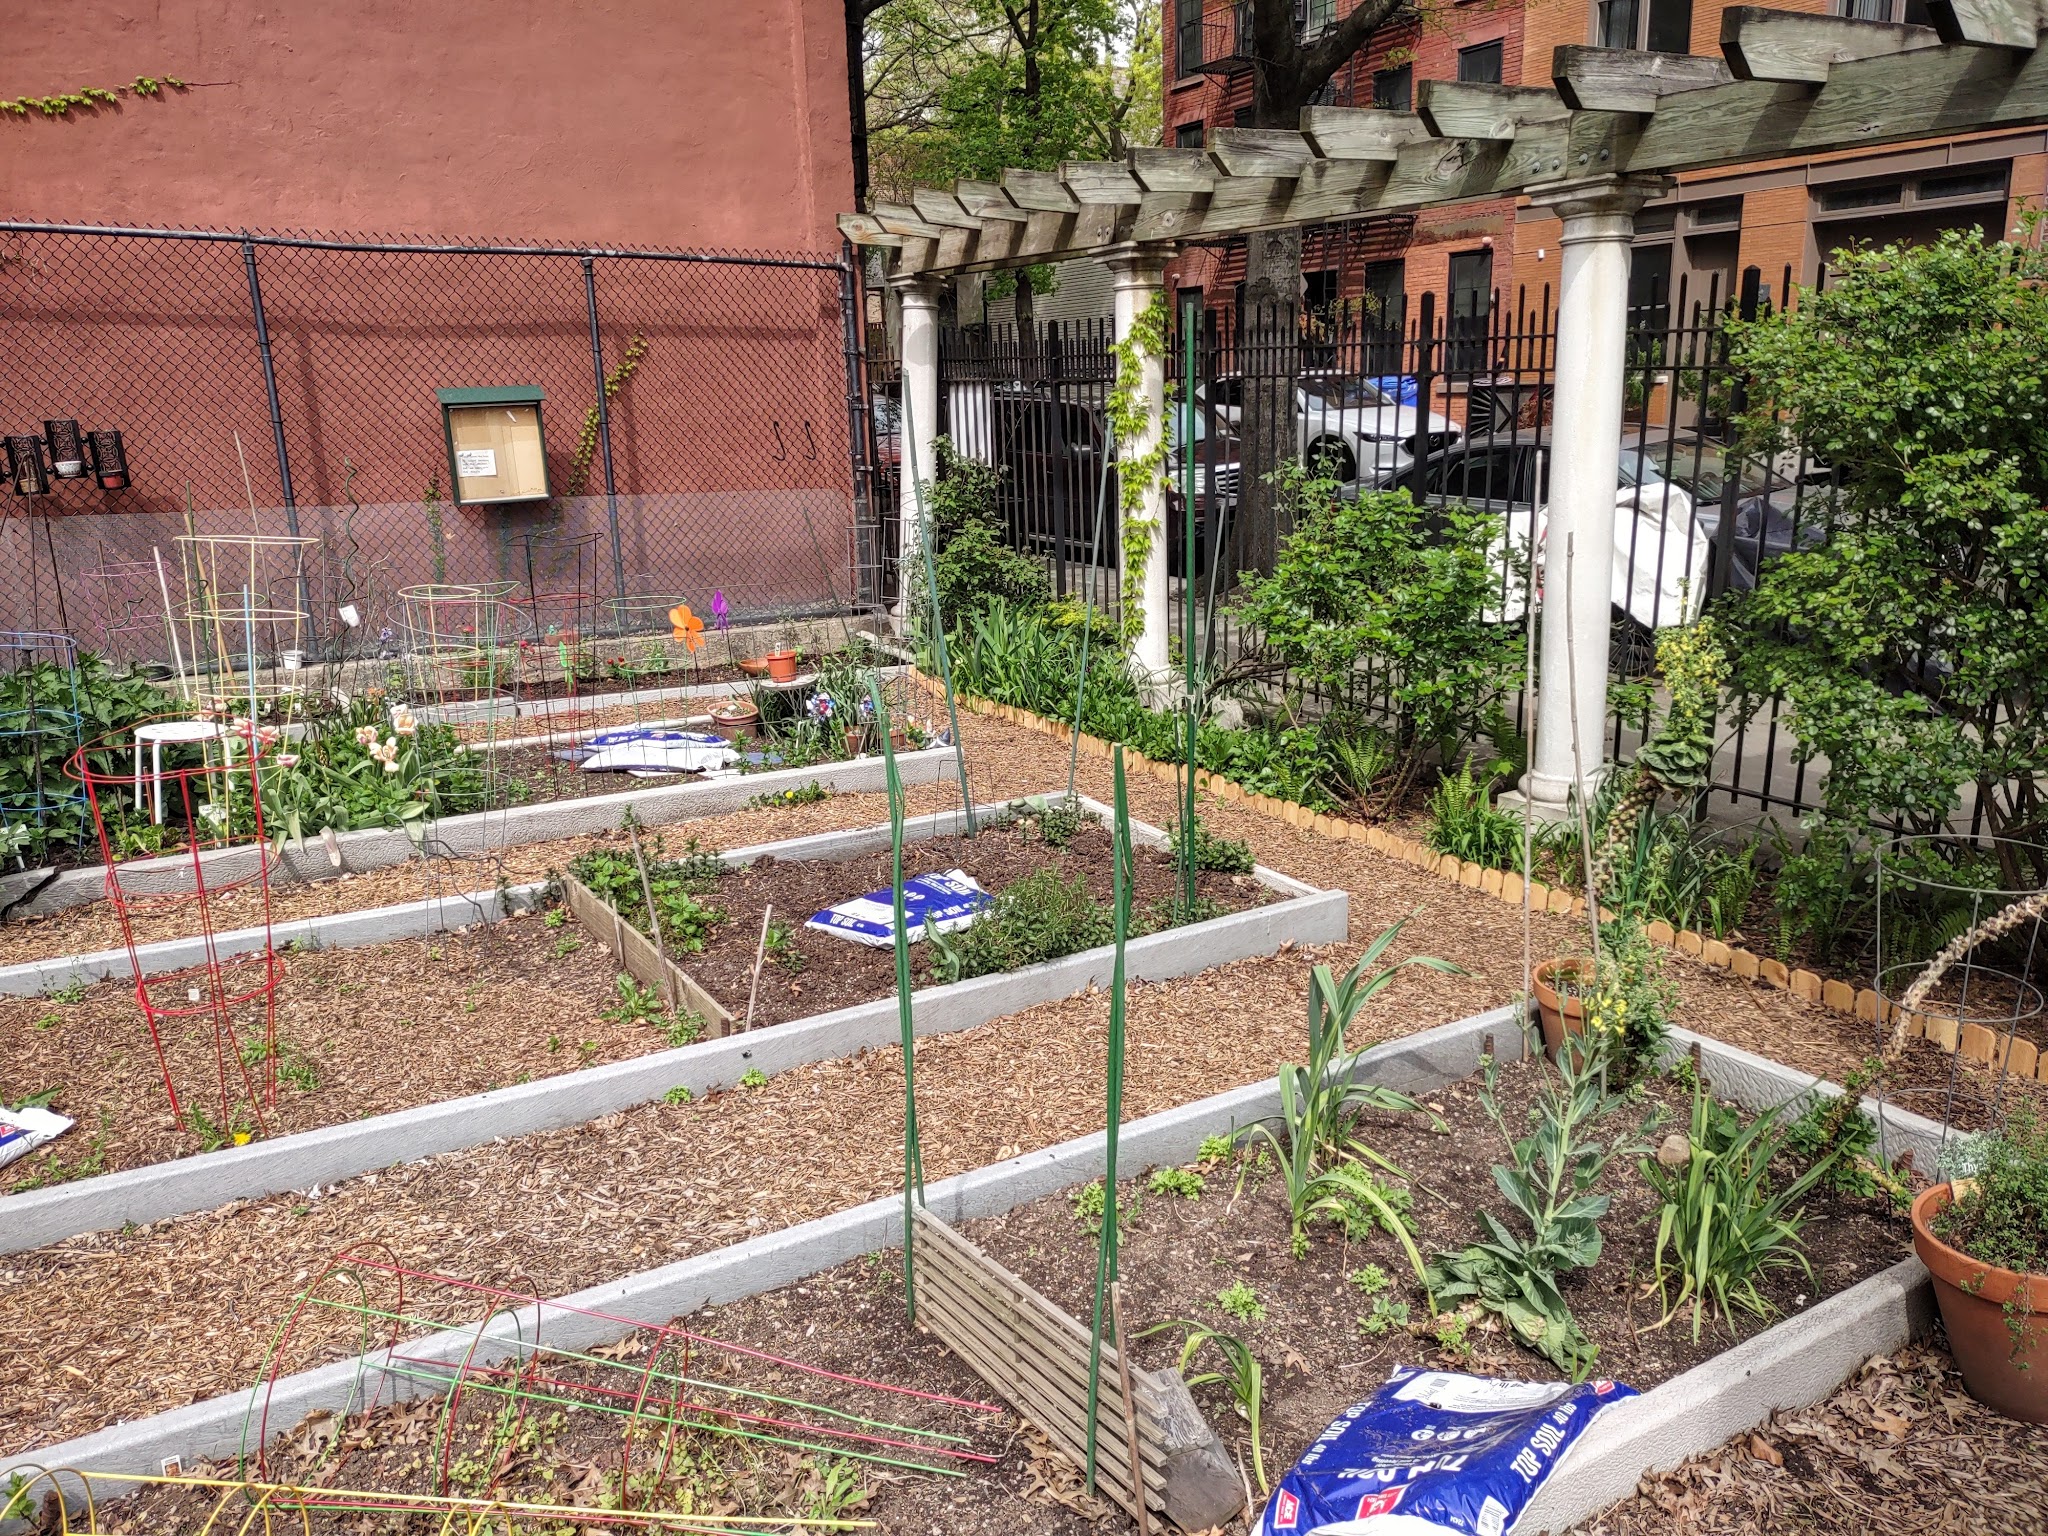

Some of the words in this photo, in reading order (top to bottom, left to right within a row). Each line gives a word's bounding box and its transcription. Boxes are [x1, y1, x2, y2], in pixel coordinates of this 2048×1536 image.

[1961, 1162, 1983, 1174] Thy
[1346, 1401, 1373, 1419] TOP
[1557, 1402, 1578, 1416] lbs
[1552, 1411, 1569, 1425] 40
[1315, 1420, 1352, 1443] SOIL
[1530, 1423, 1566, 1457] SOIL
[1311, 1443, 1327, 1454] 40
[1301, 1453, 1321, 1465] lbs
[1510, 1446, 1542, 1484] TOP
[1283, 1499, 1295, 1520] ACE
